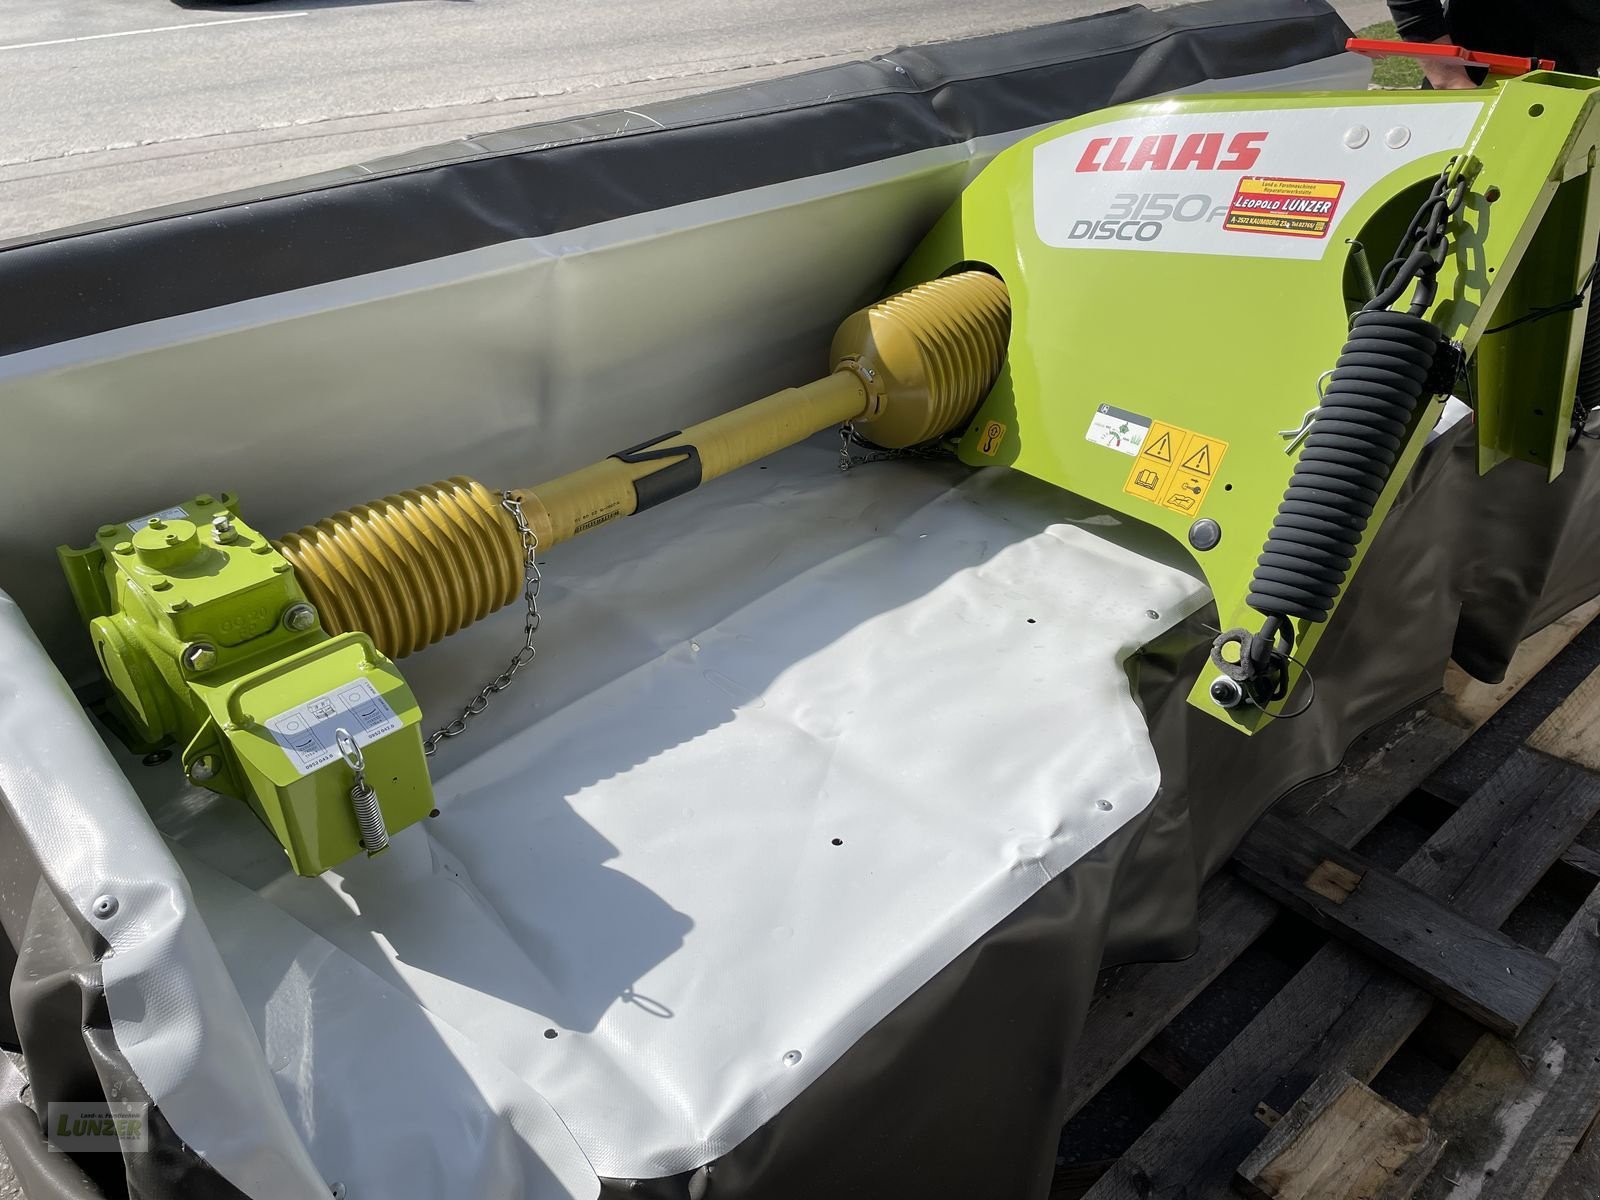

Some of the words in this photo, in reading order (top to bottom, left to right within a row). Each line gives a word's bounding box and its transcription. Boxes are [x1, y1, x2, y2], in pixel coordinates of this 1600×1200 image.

[1075, 131, 1269, 173] CLAAS
[1282, 199, 1331, 213] LUNZER
[1067, 219, 1163, 242] DISCO
